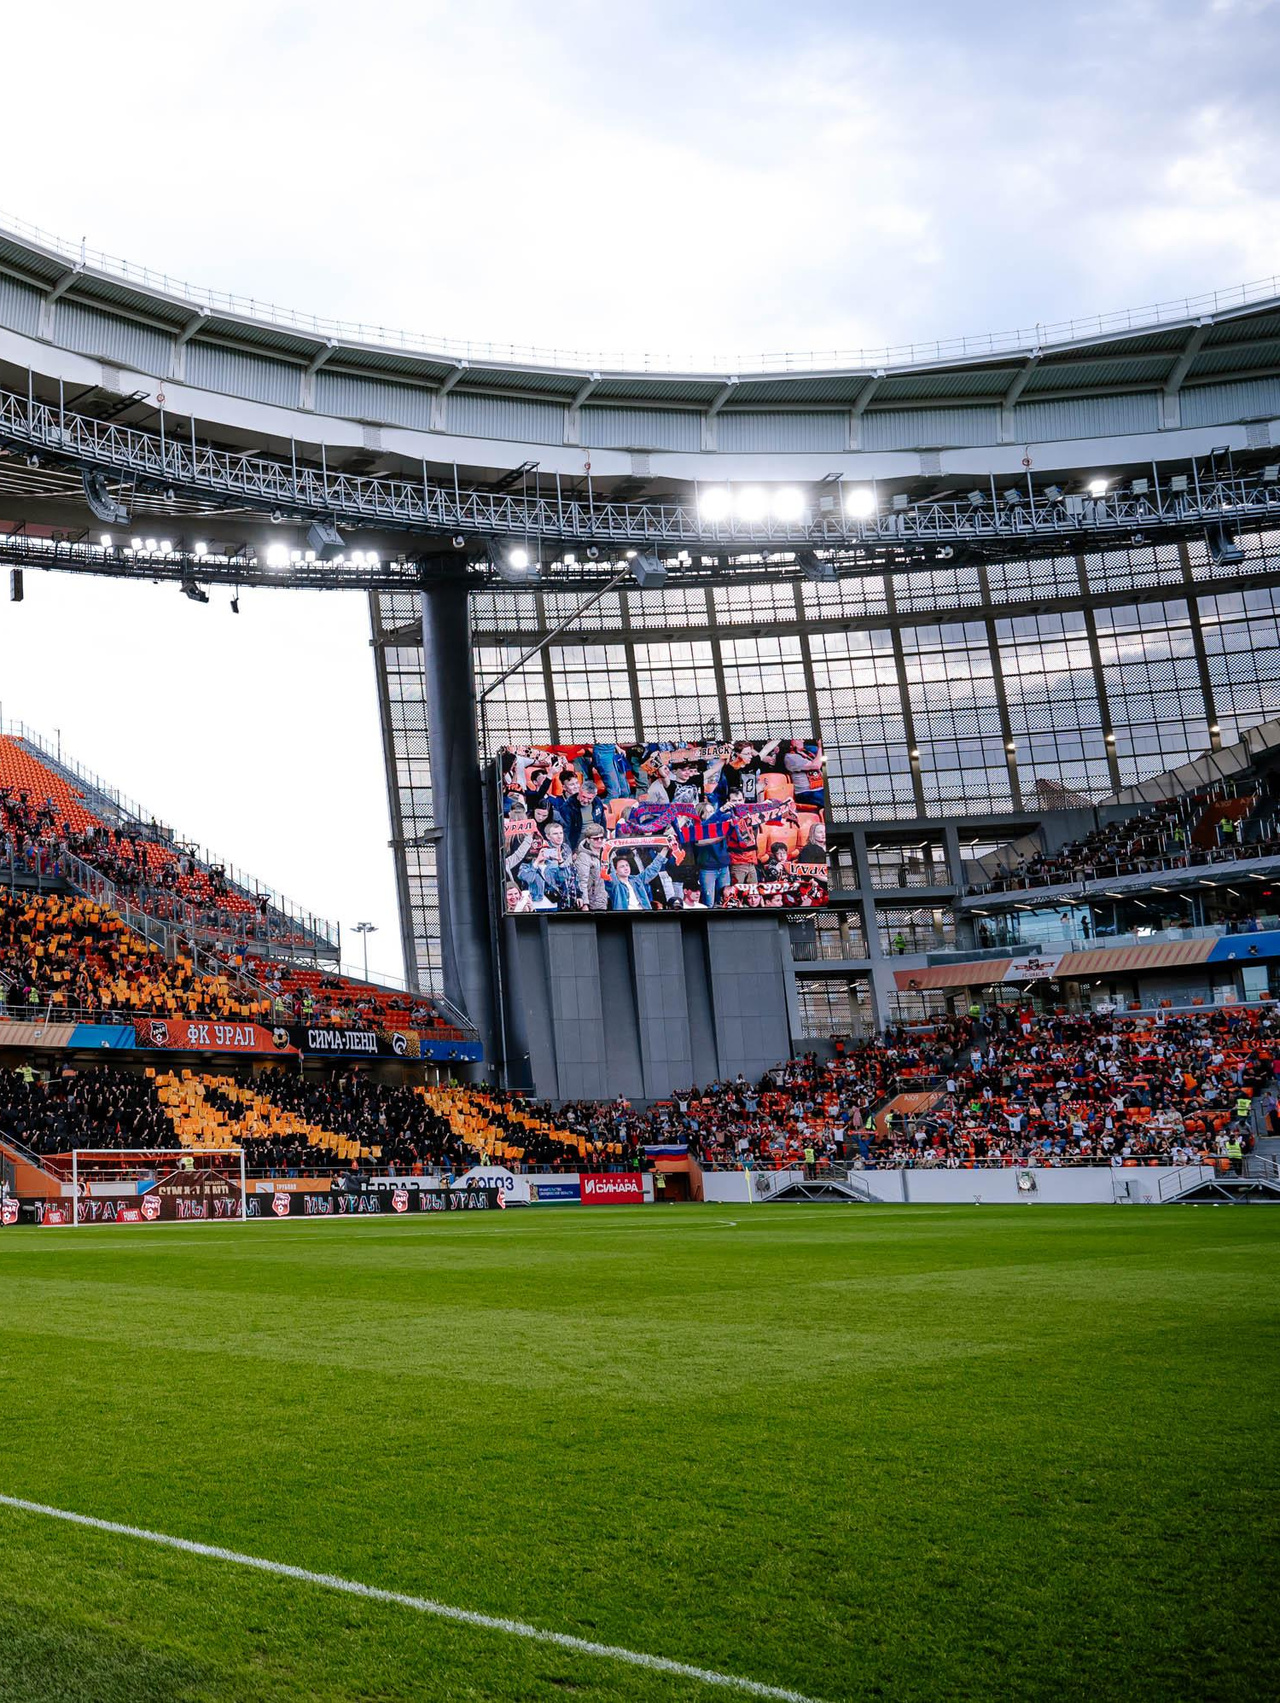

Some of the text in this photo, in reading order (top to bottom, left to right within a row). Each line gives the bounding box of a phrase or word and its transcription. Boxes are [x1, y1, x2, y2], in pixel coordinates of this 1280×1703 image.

[187, 1024, 256, 1047] ФК УРАЛ
[308, 1029, 378, 1054] СИМА-ЛЕНД
[596, 1183, 639, 1193] СИНАРА
[338, 1194, 380, 1213] УРАЛ
[450, 1191, 489, 1210] УРАЛ
